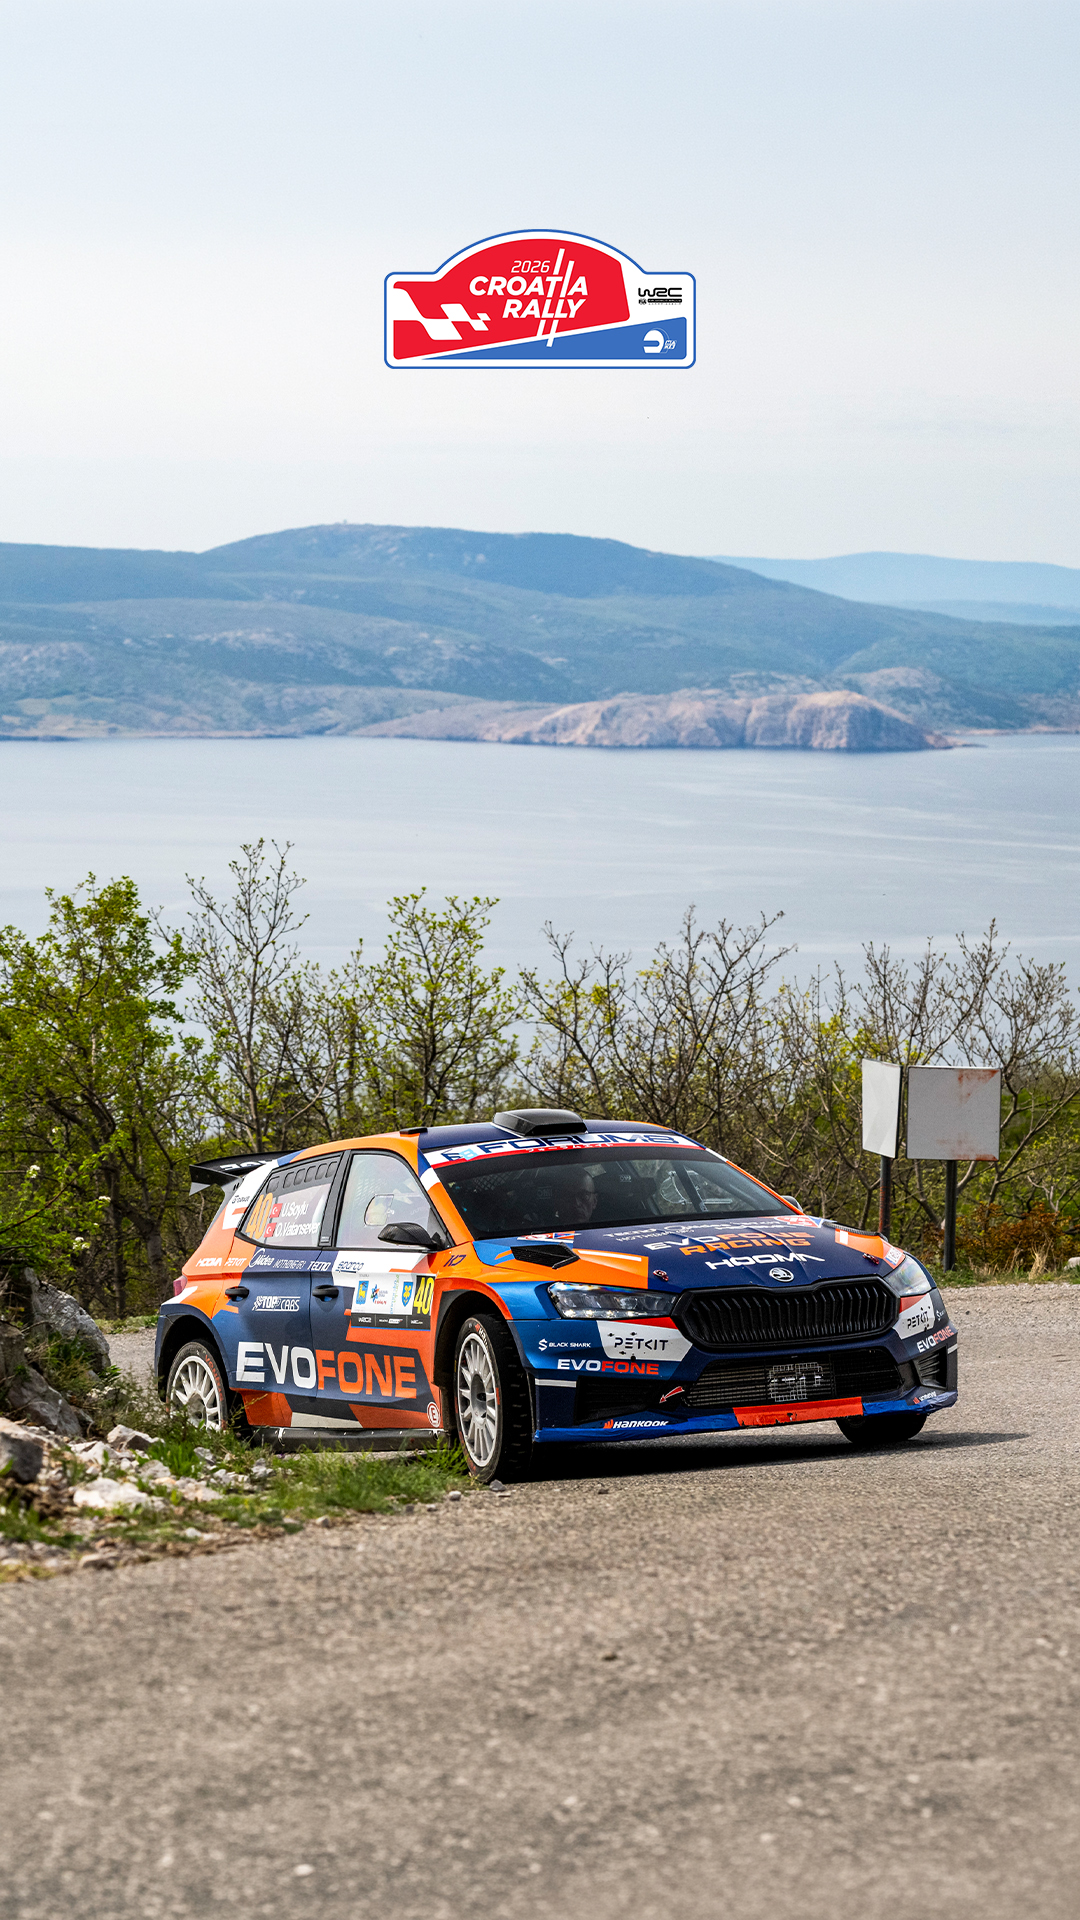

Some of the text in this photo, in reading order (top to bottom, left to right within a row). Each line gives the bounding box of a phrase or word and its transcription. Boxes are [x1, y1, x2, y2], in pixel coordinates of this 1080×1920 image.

[477, 1134, 680, 1154] FORUM8
[679, 1238, 812, 1256] RACING
[414, 1277, 435, 1315] 40
[614, 1337, 669, 1351] PETKIT
[916, 1325, 955, 1353] EVOFONE
[236, 1341, 418, 1399] EVOFONE
[557, 1359, 660, 1375] EVOFONE
